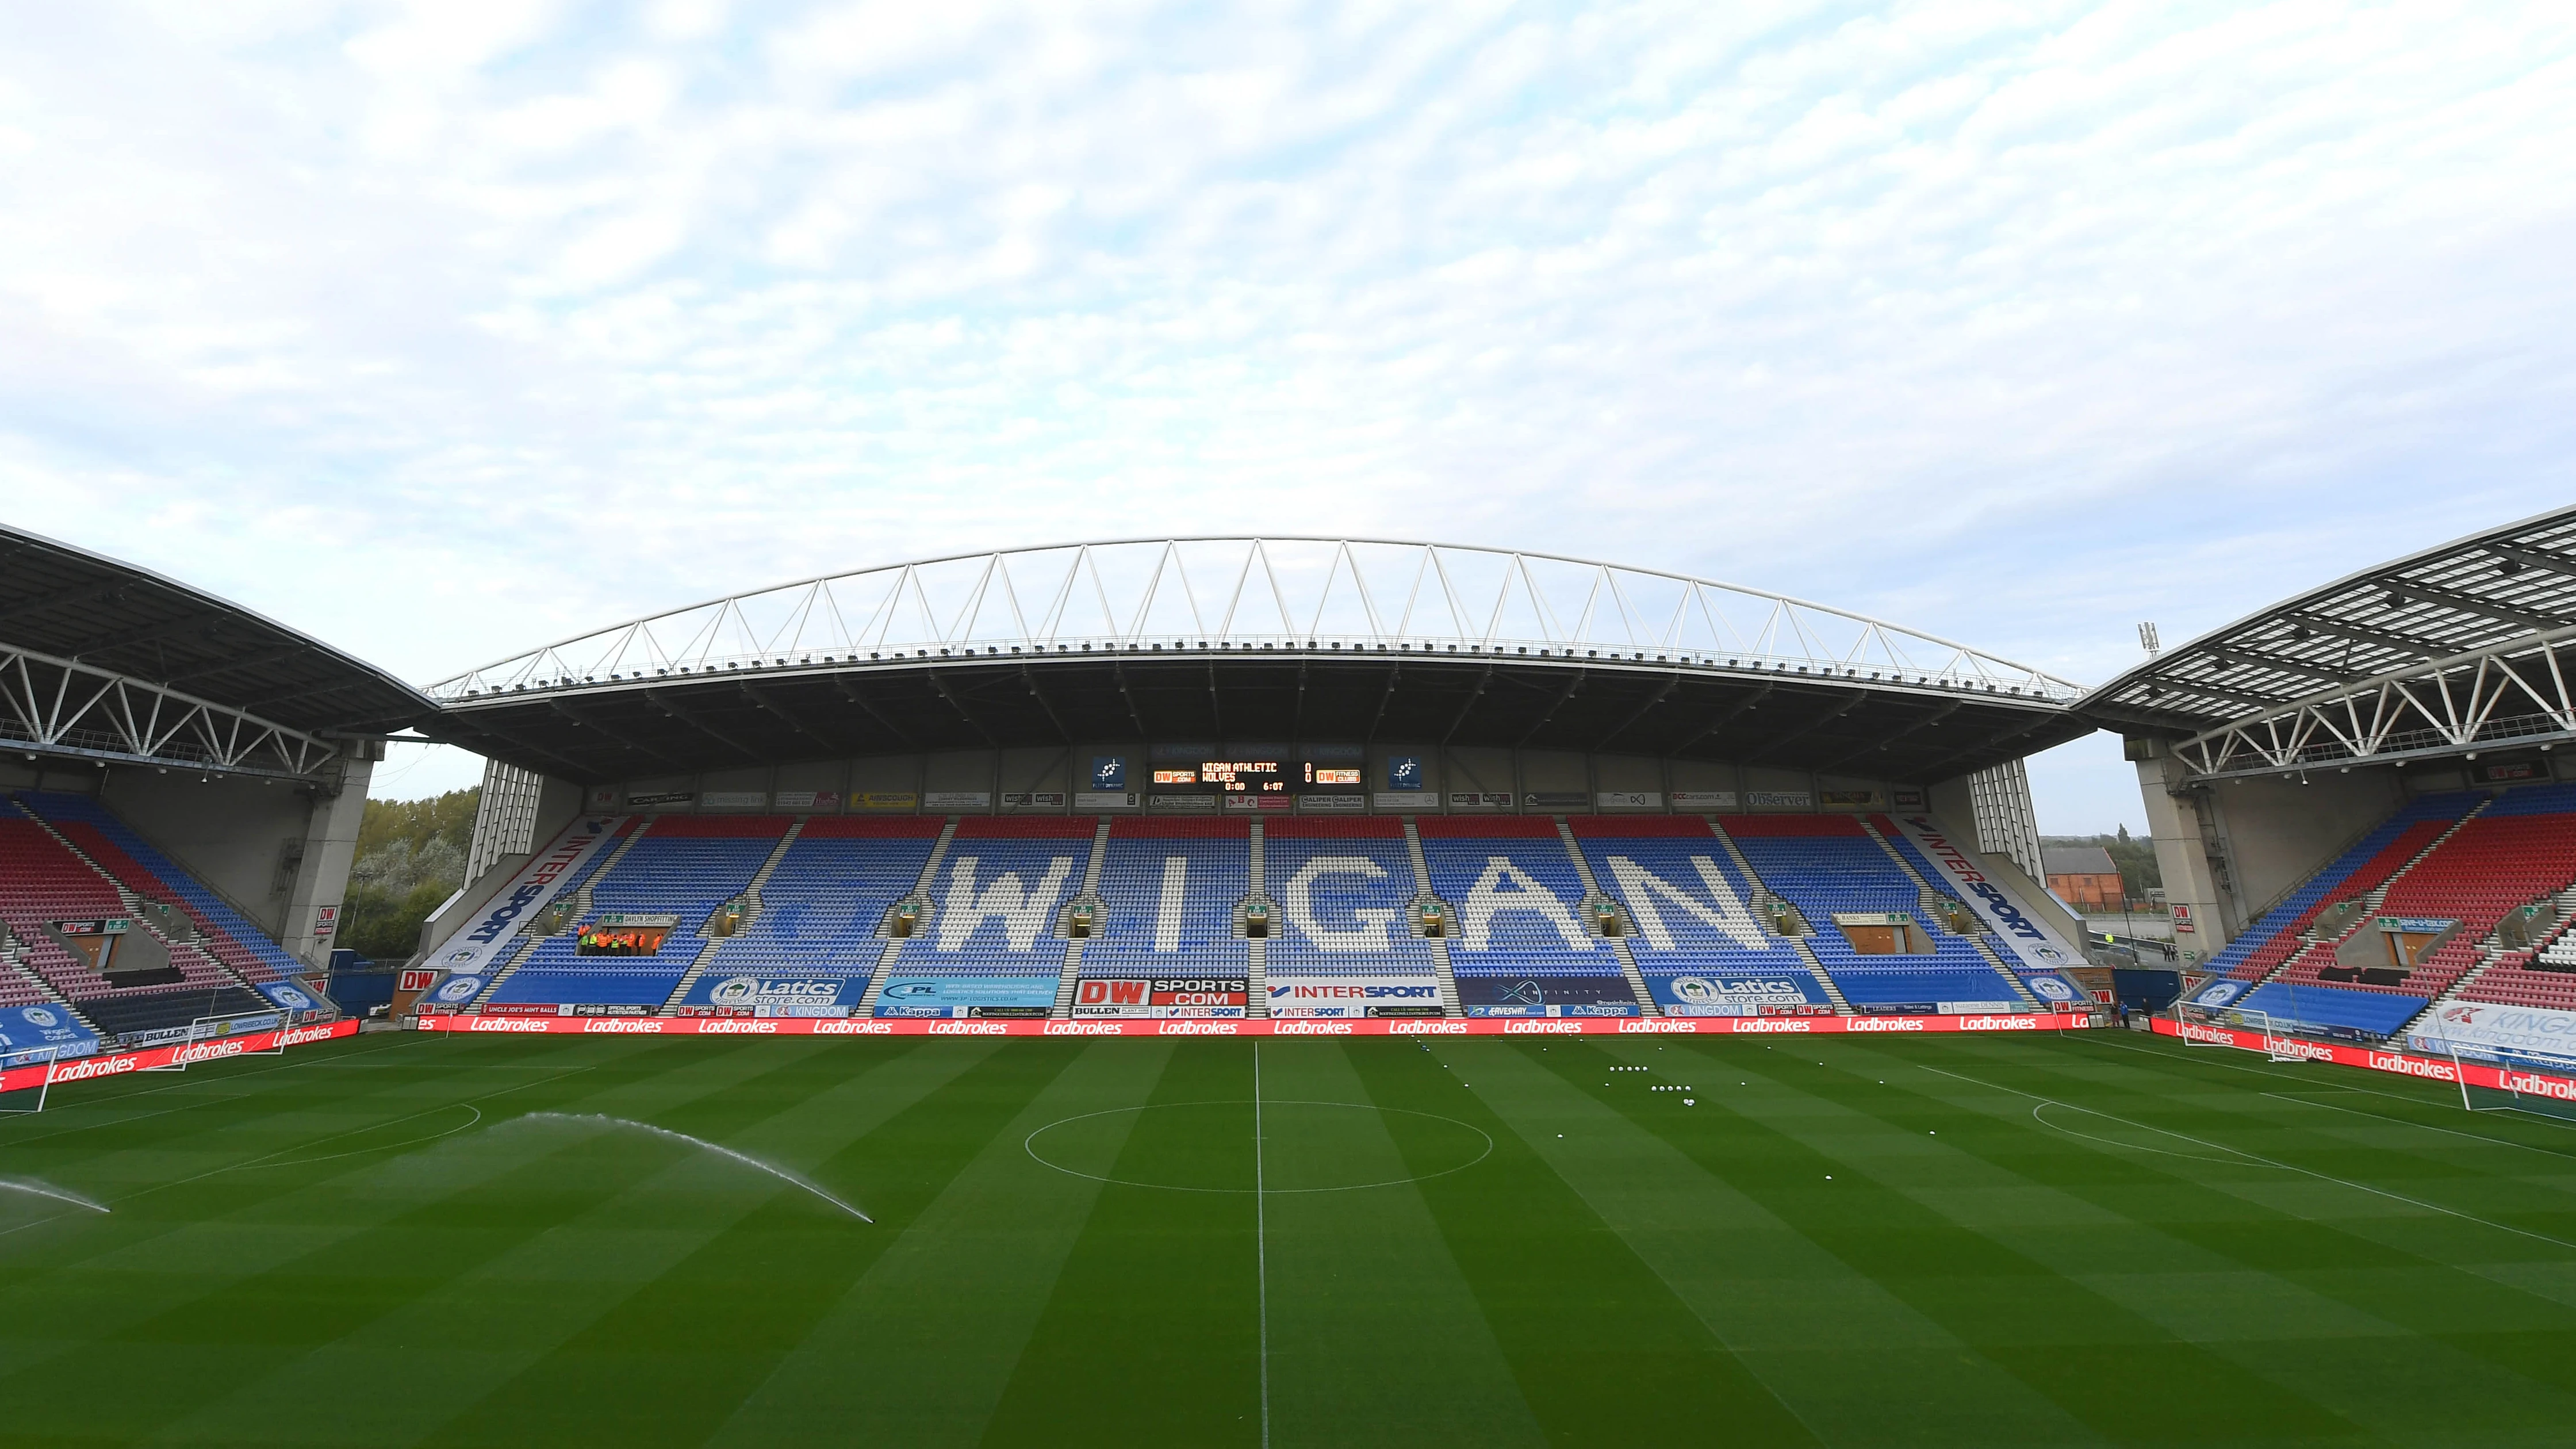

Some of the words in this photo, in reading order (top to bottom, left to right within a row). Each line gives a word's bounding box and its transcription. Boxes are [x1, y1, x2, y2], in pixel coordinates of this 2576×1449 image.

[1202, 762, 1231, 772] WIGAN
[1232, 762, 1277, 772] ATHLETIC
[1305, 762, 1312, 773] 0
[1155, 772, 1171, 781] DW
[1202, 772, 1236, 782] WOLVES
[1305, 773, 1312, 783] 0
[1318, 772, 1335, 781] DW
[1225, 783, 1245, 791] 0:00
[1263, 783, 1283, 791] 6:07
[597, 792, 612, 802] DW
[718, 796, 747, 804] missing
[1747, 793, 1809, 805] Observer
[467, 835, 596, 944] INTERSPORT
[1918, 834, 2046, 941] INTERSPORT
[937, 856, 1769, 952] WIGAN
[320, 908, 335, 921] DW
[2174, 906, 2188, 918] DW
[63, 923, 76, 932] DW
[404, 972, 434, 989] DW
[1154, 980, 1245, 991] SPORTS
[1713, 979, 1795, 994] Latics
[758, 979, 837, 995] Latics
[1079, 981, 1147, 1004] DW
[1294, 986, 1437, 998] INTERSPORT
[754, 996, 830, 1005] store.com
[1169, 993, 1229, 1005] .COM
[1724, 995, 1801, 1004] store.com
[418, 1004, 434, 1014] DW
[679, 1007, 693, 1015] DW
[718, 1007, 732, 1015] DW
[795, 1006, 846, 1016] KINGDOM
[900, 1007, 941, 1017] Kappa
[1181, 1008, 1241, 1017] INTERSPORT
[1285, 1007, 1345, 1016] INTERSPORT
[1488, 1007, 1527, 1016] EAVESWAY
[1586, 1006, 1628, 1016] Kappa
[1689, 1005, 1739, 1015] KINGDOM
[1760, 1006, 1774, 1014] DW
[1798, 1006, 1812, 1014] DW
[2054, 1002, 2069, 1011] DW
[304, 1010, 317, 1022] DW
[471, 1017, 549, 1032] Ladbrokes
[584, 1018, 663, 1033] Ladbrokes
[699, 1019, 777, 1033] Ladbrokes
[814, 1019, 892, 1034] Ladbrokes
[929, 1021, 1007, 1034] Ladbrokes
[1044, 1021, 1122, 1034] Ladbrokes
[1159, 1021, 1237, 1034] Ladbrokes
[1274, 1021, 1352, 1034] Ladbrokes
[1389, 1020, 1467, 1034] Ladbrokes
[1504, 1019, 1582, 1033] Ladbrokes
[1618, 1019, 1696, 1033] Ladbrokes
[1733, 1018, 1810, 1032] Ladbrokes
[1846, 1017, 1923, 1031] Ladbrokes
[1960, 1016, 2035, 1030] Ladbrokes
[144, 1028, 189, 1042] BULLEN
[273, 1026, 334, 1047] Ladbrokes
[2176, 1022, 2233, 1045] Ladbrokes
[37, 1041, 98, 1061] KINGDOM
[171, 1038, 244, 1063] Ladbrokes
[2264, 1036, 2333, 1061] Ladbrokes
[49, 1056, 137, 1083] Ladbrokes
[2368, 1051, 2455, 1081] Ladbrokes
